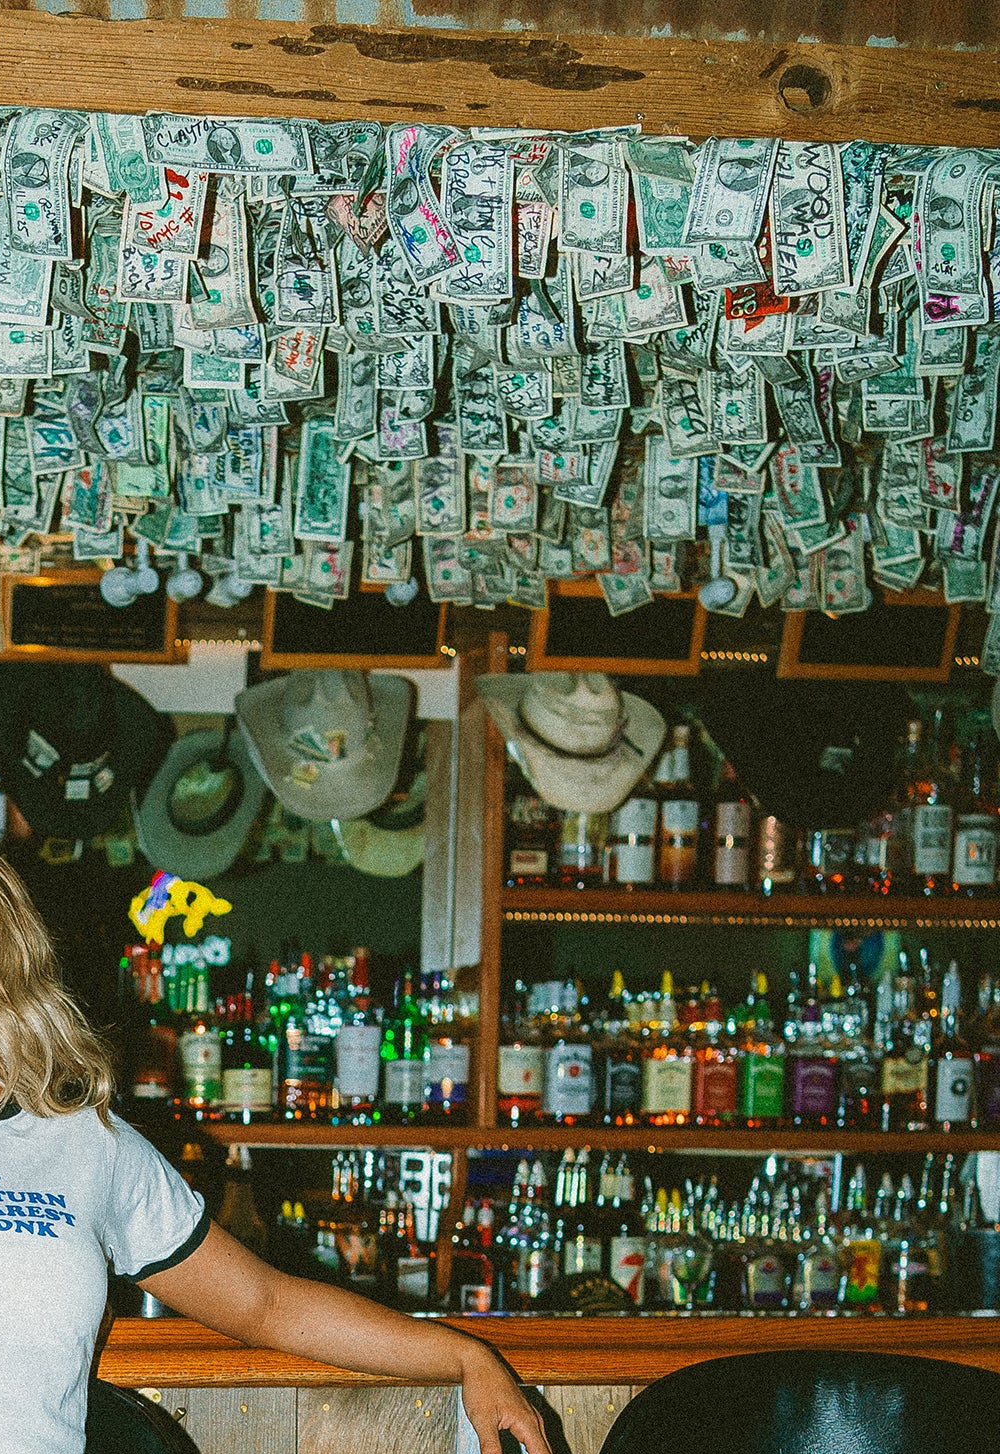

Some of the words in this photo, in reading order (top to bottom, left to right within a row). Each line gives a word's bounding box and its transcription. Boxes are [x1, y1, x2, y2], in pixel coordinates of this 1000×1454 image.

[803, 144, 833, 239] WOOD
[793, 202, 815, 251] WAS
[776, 231, 800, 296] HEAR
